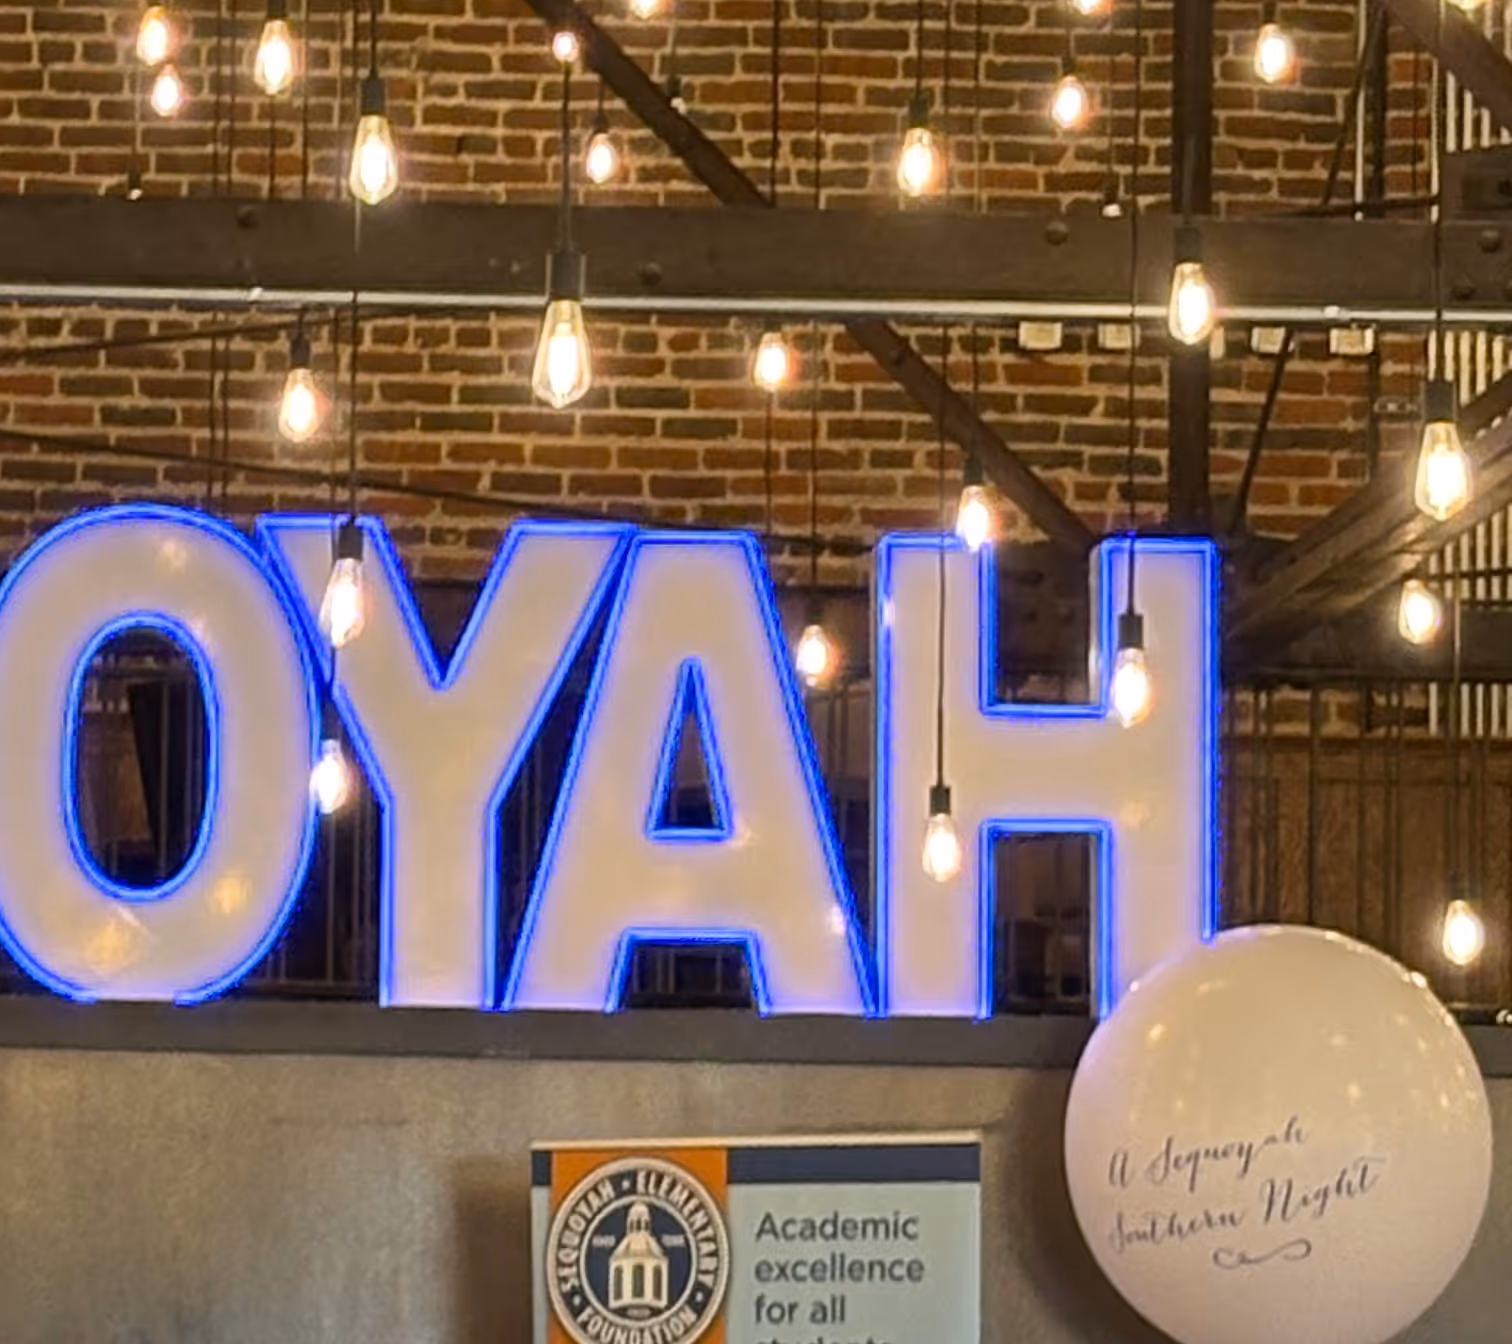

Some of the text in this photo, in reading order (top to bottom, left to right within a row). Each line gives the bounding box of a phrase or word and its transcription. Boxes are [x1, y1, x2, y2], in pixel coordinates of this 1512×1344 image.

[1107, 1114, 1310, 1194] A Sequoyah
[557, 1170, 719, 1293] SEQUOYAH ELEMENTARY
[754, 1209, 920, 1242] Academic
[1107, 1156, 1386, 1255] Southern Night
[753, 1250, 926, 1283] excellence
[754, 1292, 847, 1326] for all
